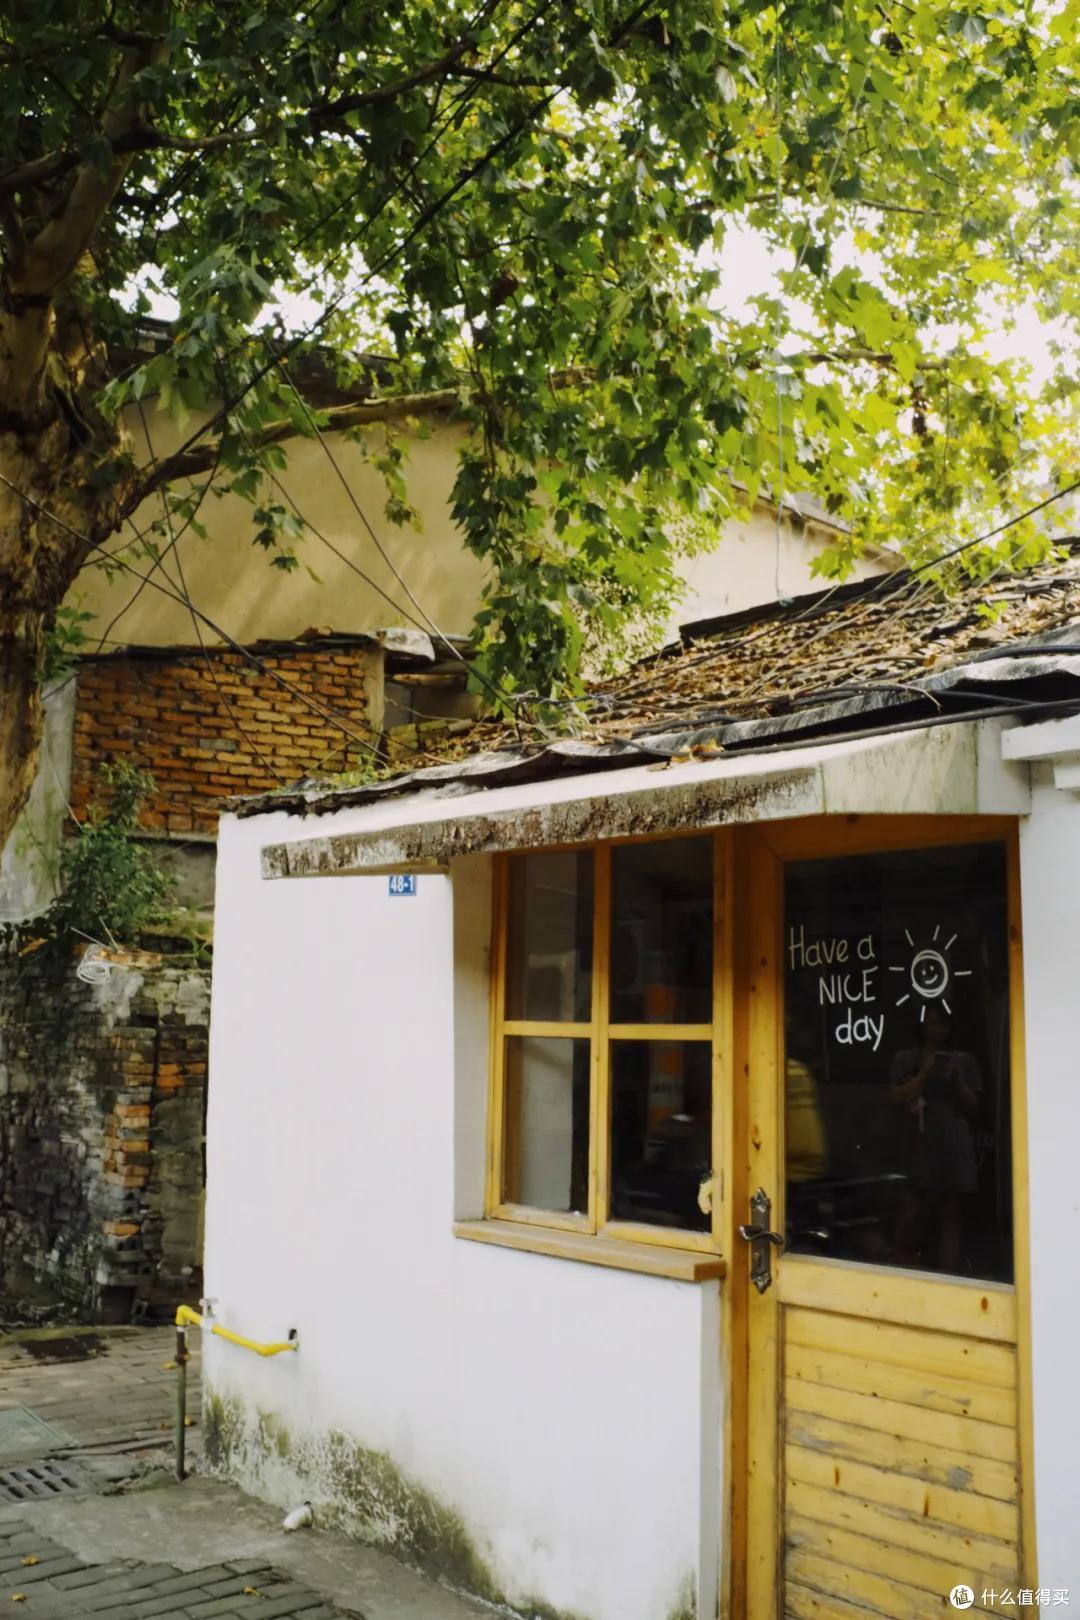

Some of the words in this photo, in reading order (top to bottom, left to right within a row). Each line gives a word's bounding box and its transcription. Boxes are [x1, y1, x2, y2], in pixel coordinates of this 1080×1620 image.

[390, 875, 414, 892] 48-1
[788, 924, 849, 970] Have
[857, 934, 876, 960] a
[819, 966, 878, 1005] NICE
[835, 1007, 884, 1052] day
